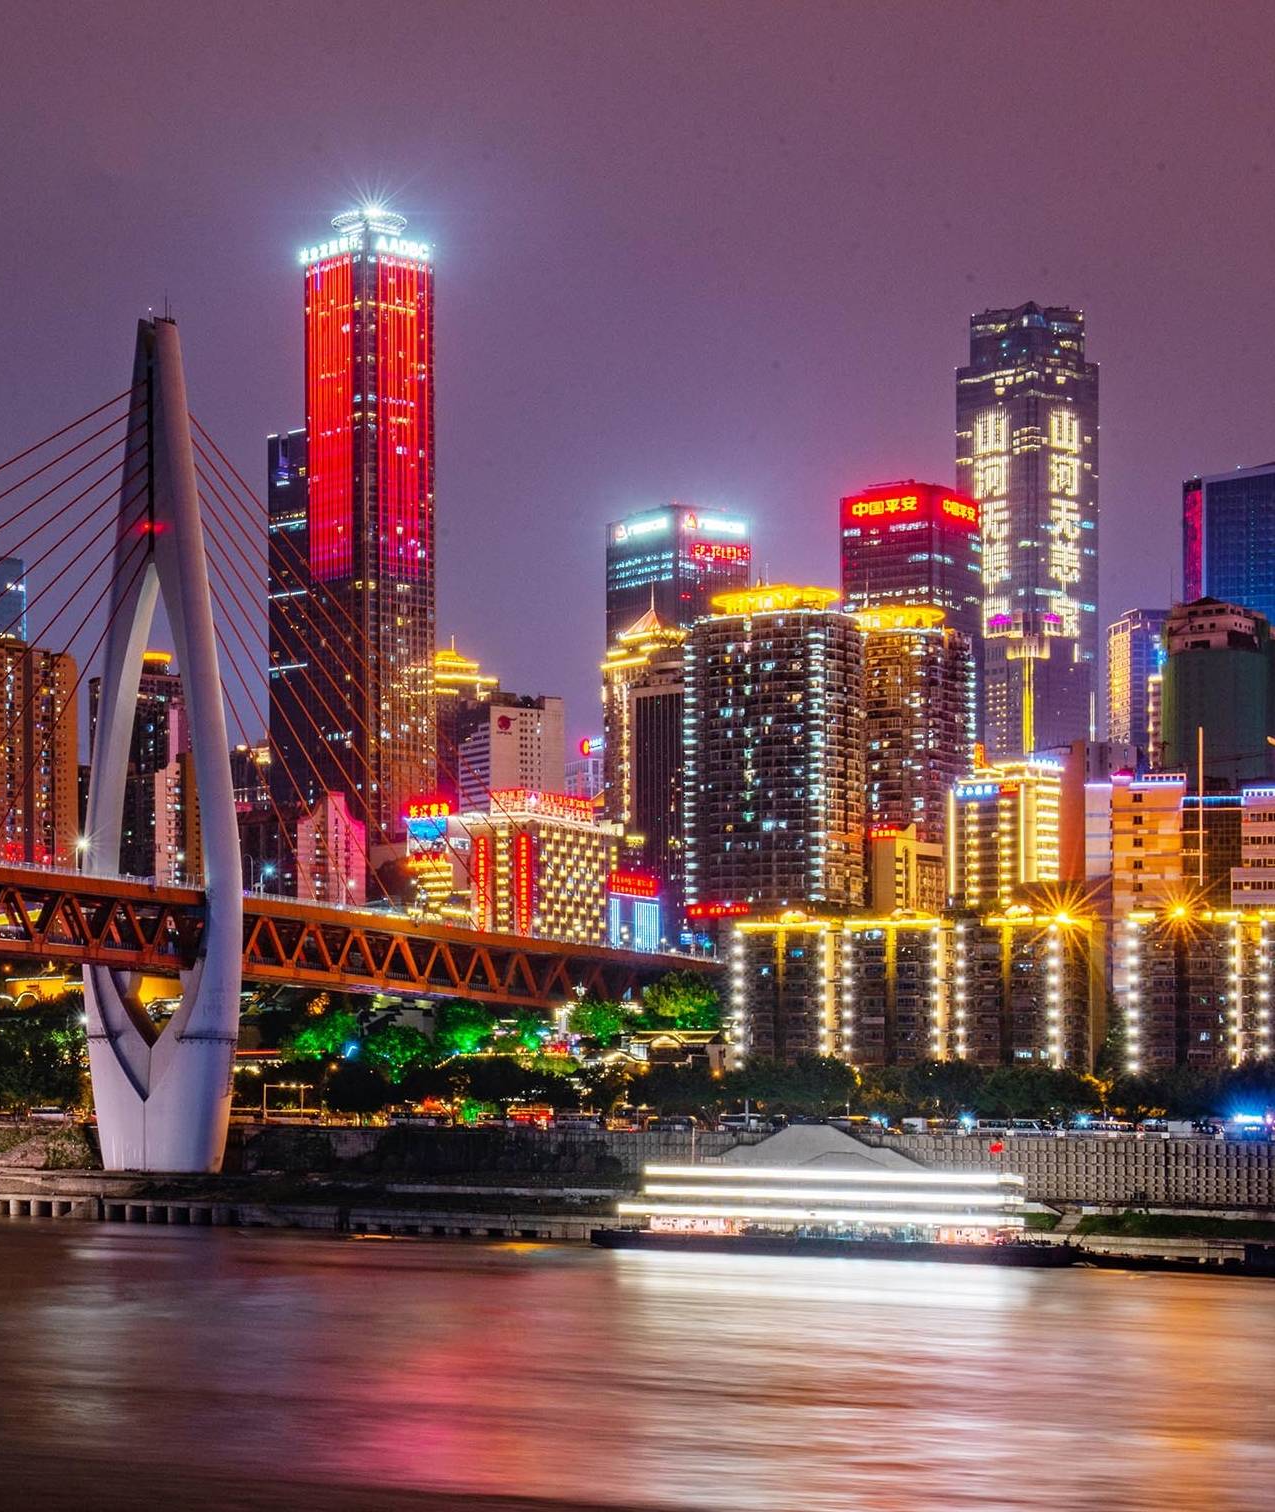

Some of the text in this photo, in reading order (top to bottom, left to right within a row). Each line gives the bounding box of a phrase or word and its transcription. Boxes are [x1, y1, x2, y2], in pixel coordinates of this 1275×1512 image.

[851, 496, 917, 517] 中国平安
[942, 499, 976, 522] 中国平安
